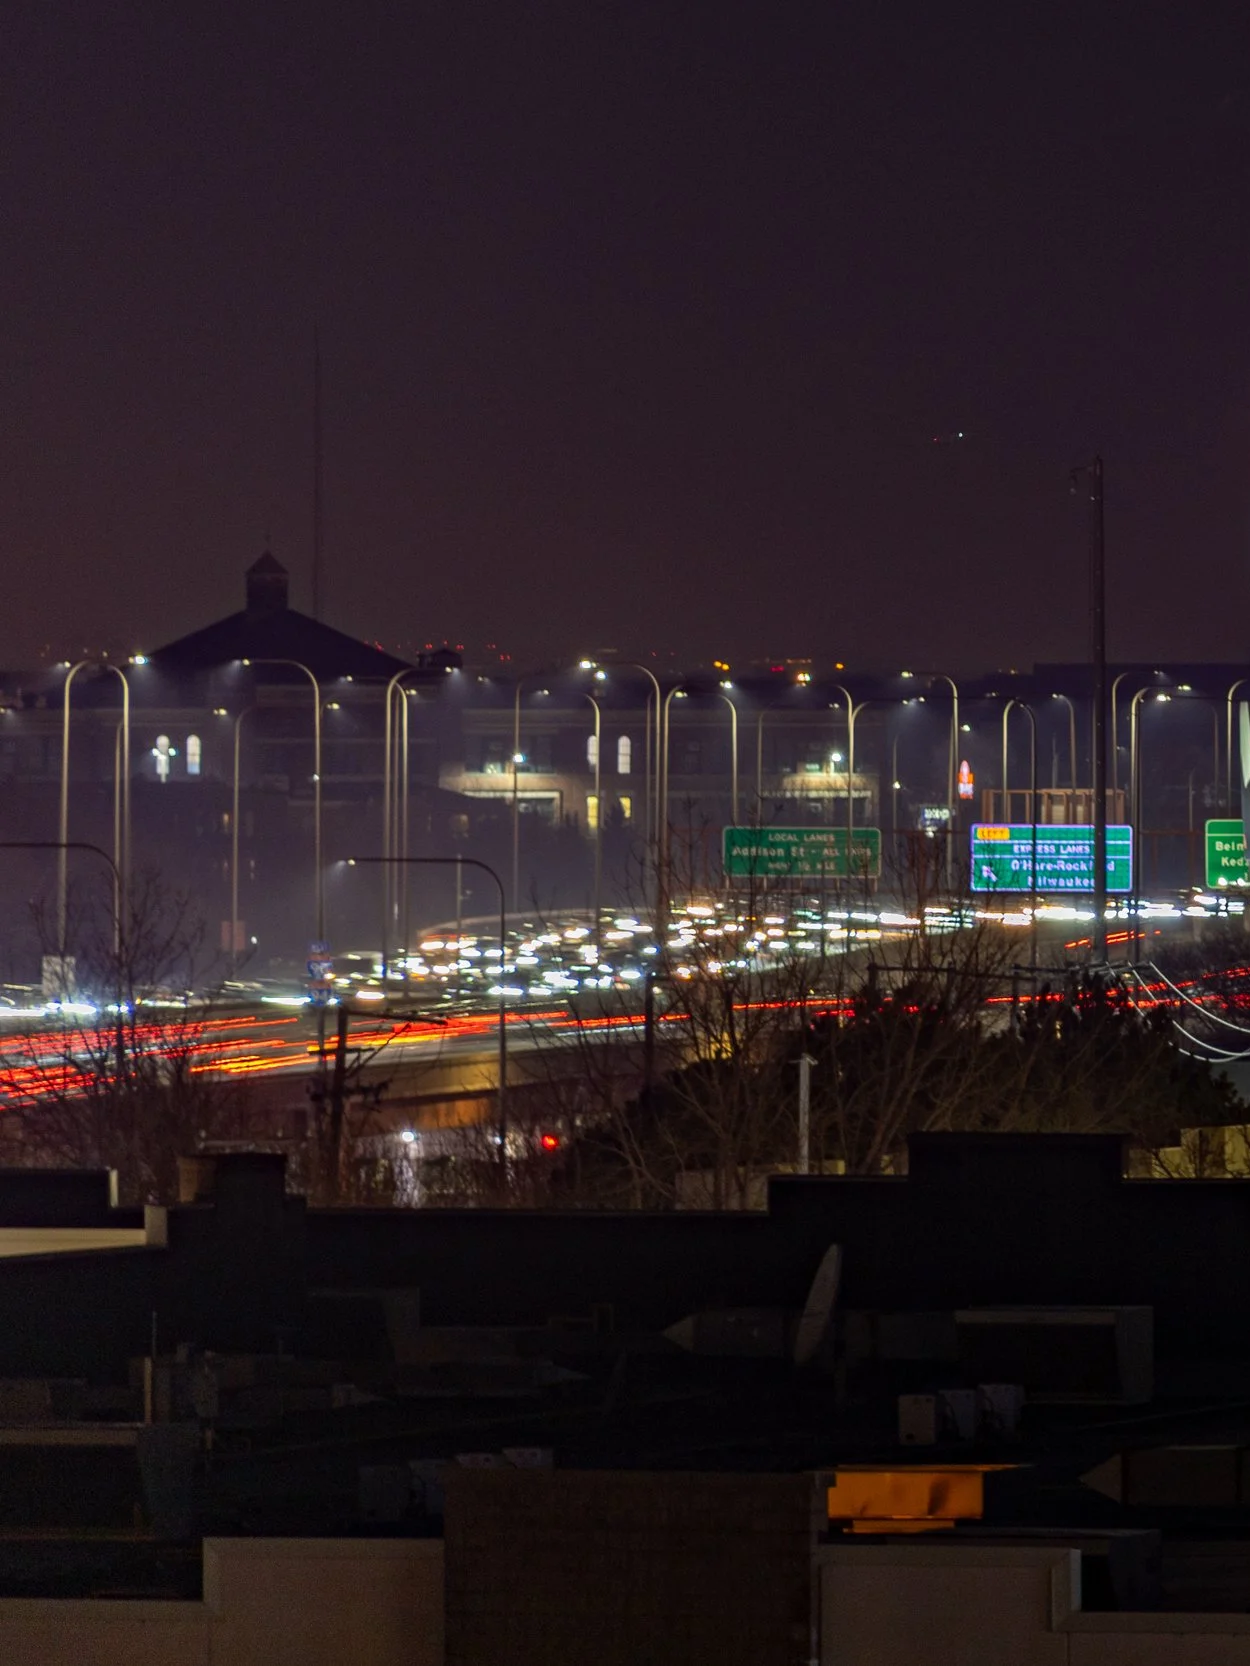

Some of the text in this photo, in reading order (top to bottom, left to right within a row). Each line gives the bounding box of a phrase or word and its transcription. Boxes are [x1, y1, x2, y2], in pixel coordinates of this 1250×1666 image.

[768, 833, 835, 842] LOCAL LANES
[1013, 845, 1090, 854] EXPESS LANES
